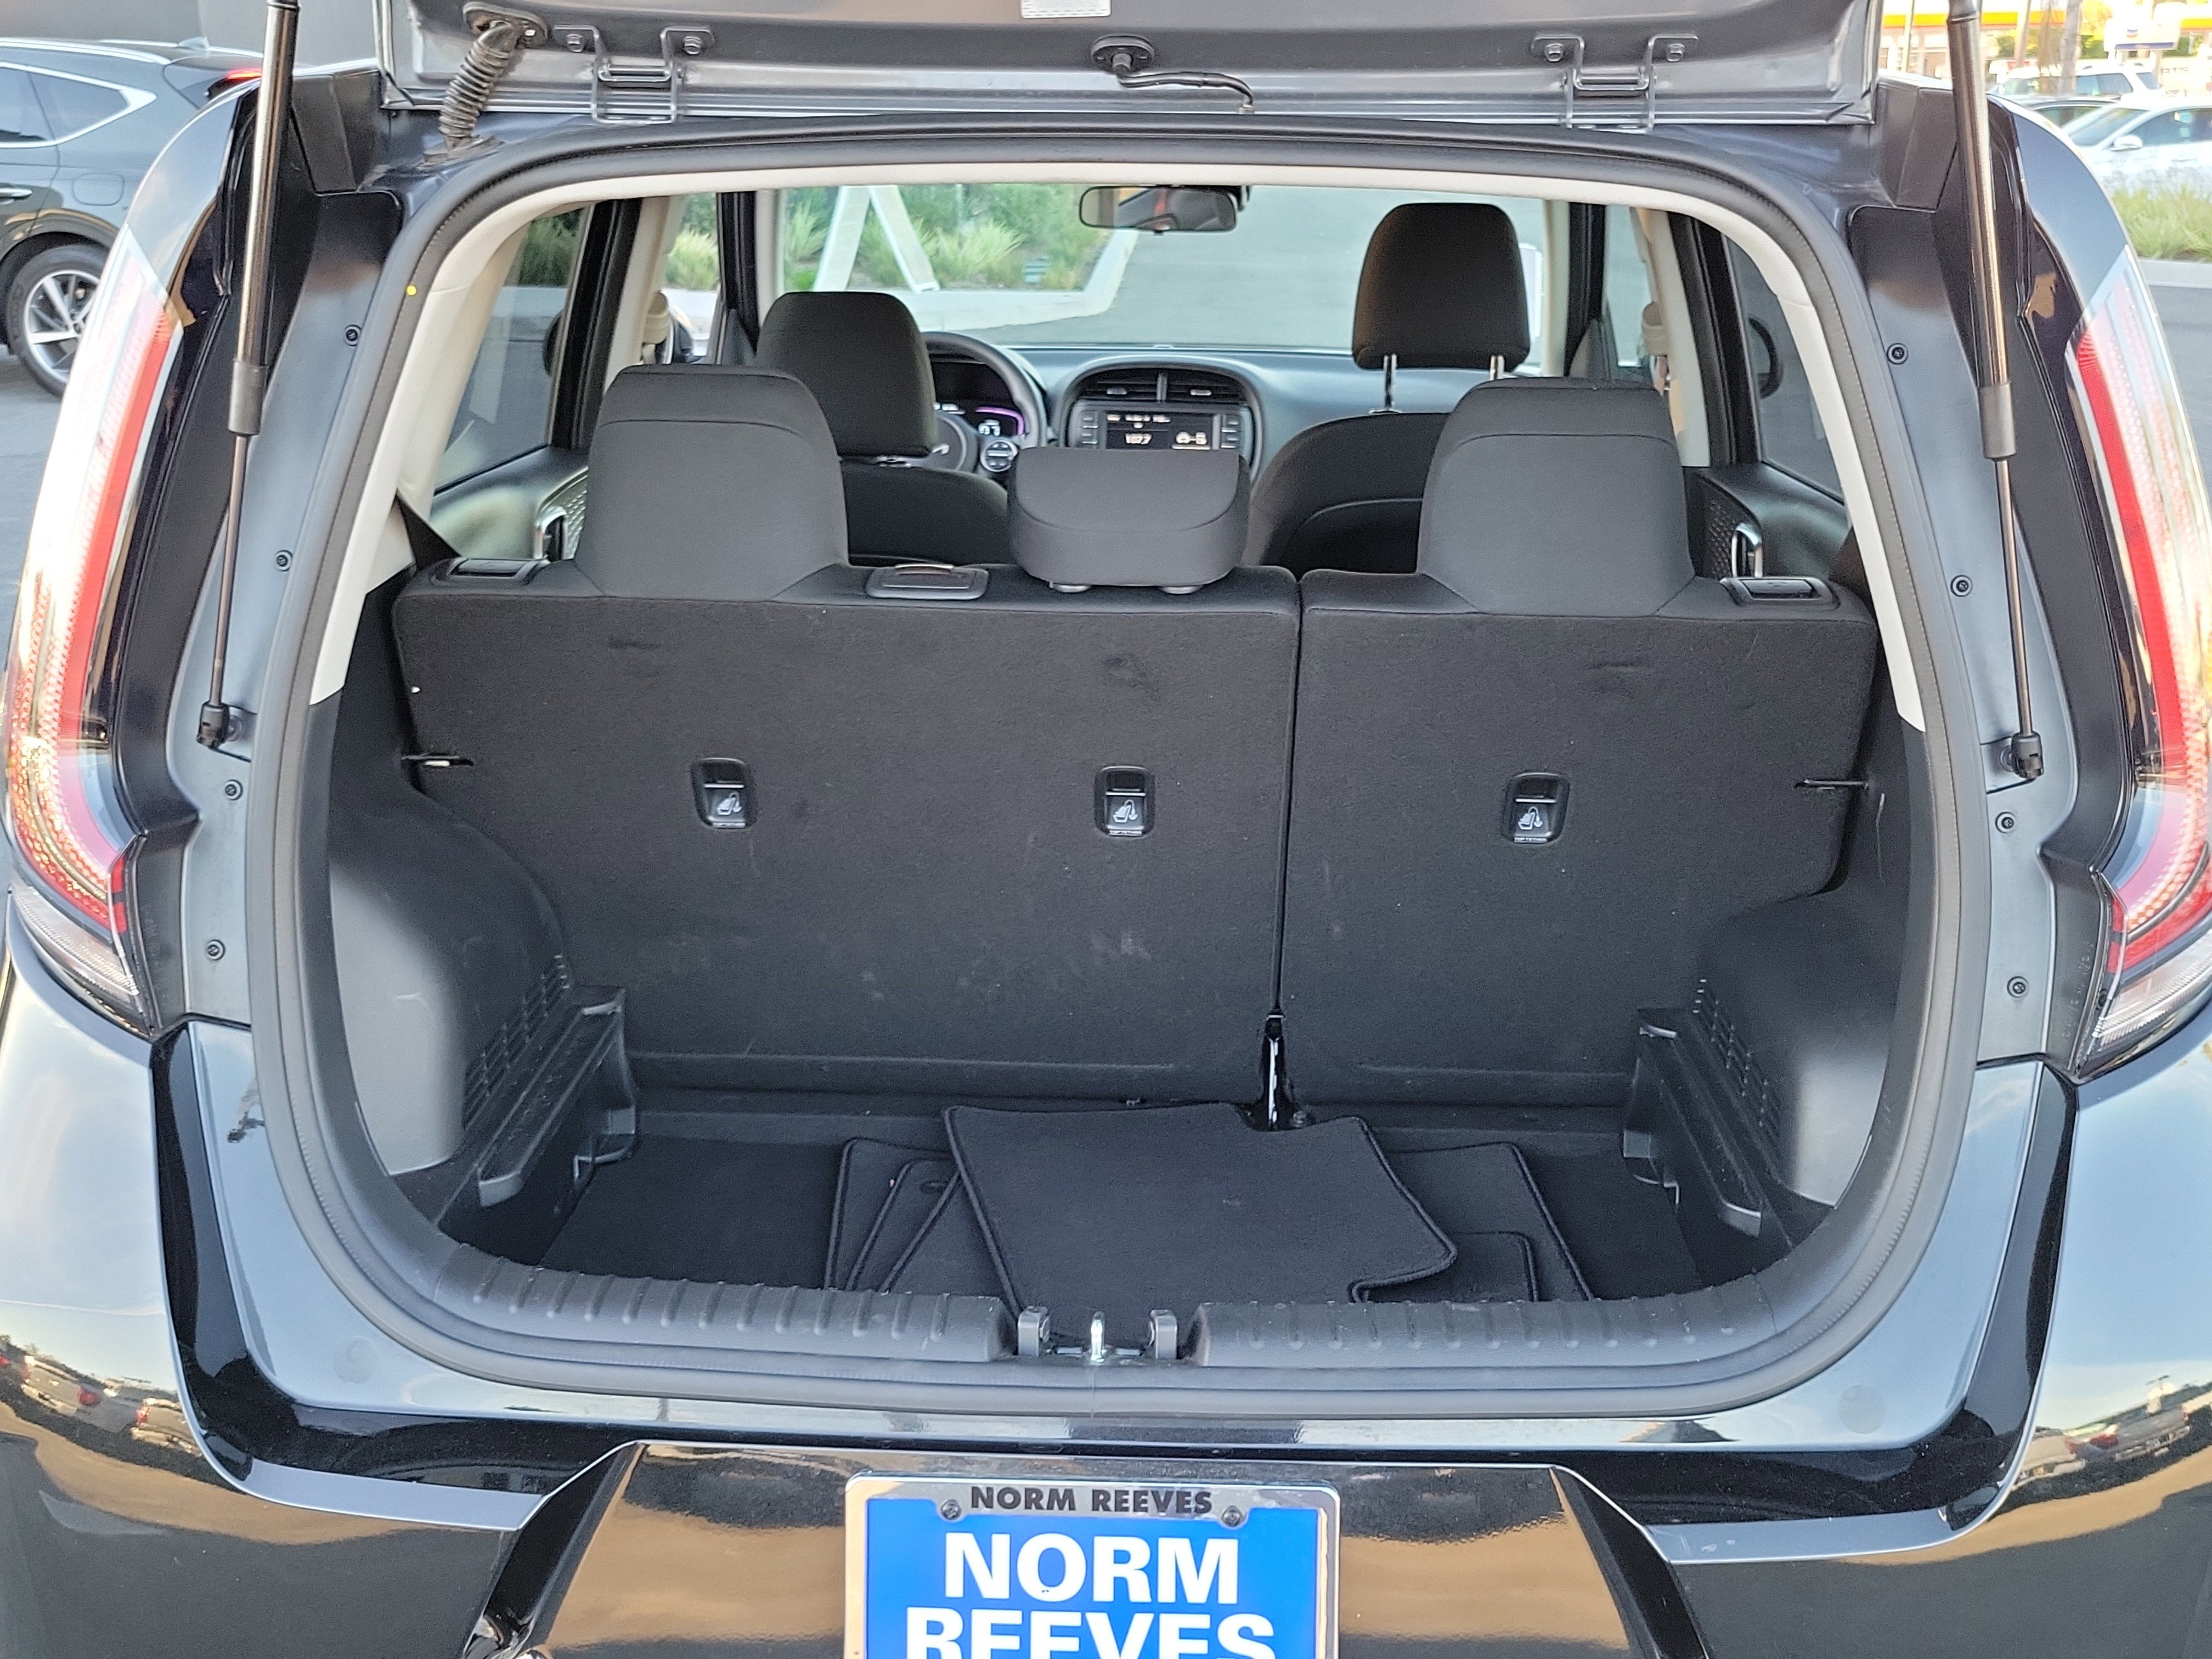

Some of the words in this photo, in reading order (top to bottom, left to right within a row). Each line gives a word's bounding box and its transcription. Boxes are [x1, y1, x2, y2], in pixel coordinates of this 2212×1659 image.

[970, 1486, 1076, 1511] NORM
[1091, 1489, 1212, 1515] REEVES
[945, 1532, 1239, 1604] NORM
[906, 1606, 1277, 1659] REEVES
